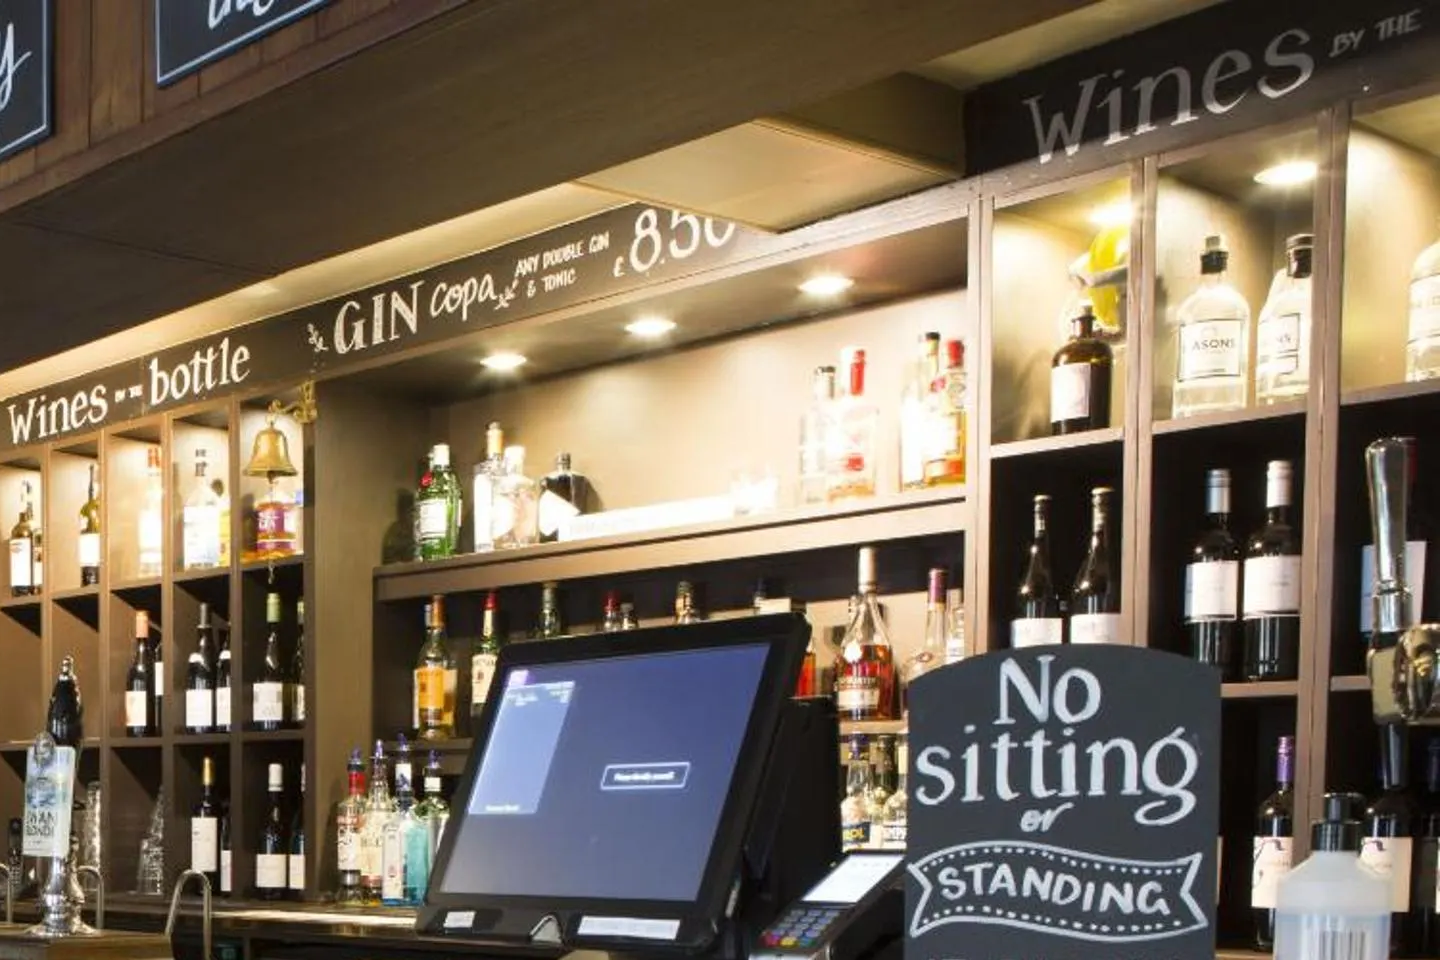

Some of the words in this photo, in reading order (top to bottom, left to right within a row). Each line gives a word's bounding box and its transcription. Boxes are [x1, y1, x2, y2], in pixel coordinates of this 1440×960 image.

[1023, 29, 1315, 165] Wines
[1329, 28, 1367, 58] BY
[1375, 8, 1422, 42] THE
[514, 254, 540, 278] ANY
[542, 241, 584, 268] DOUBLE
[589, 230, 609, 254] GIN
[541, 268, 576, 293] TONIC
[333, 280, 425, 354] GIN
[430, 273, 498, 321] copa
[7, 384, 108, 444] Wines
[149, 337, 250, 405] bottle
[993, 654, 1101, 725] No
[915, 725, 1200, 826] sitting
[1020, 801, 1075, 833] or
[938, 861, 1171, 916] STANDING
